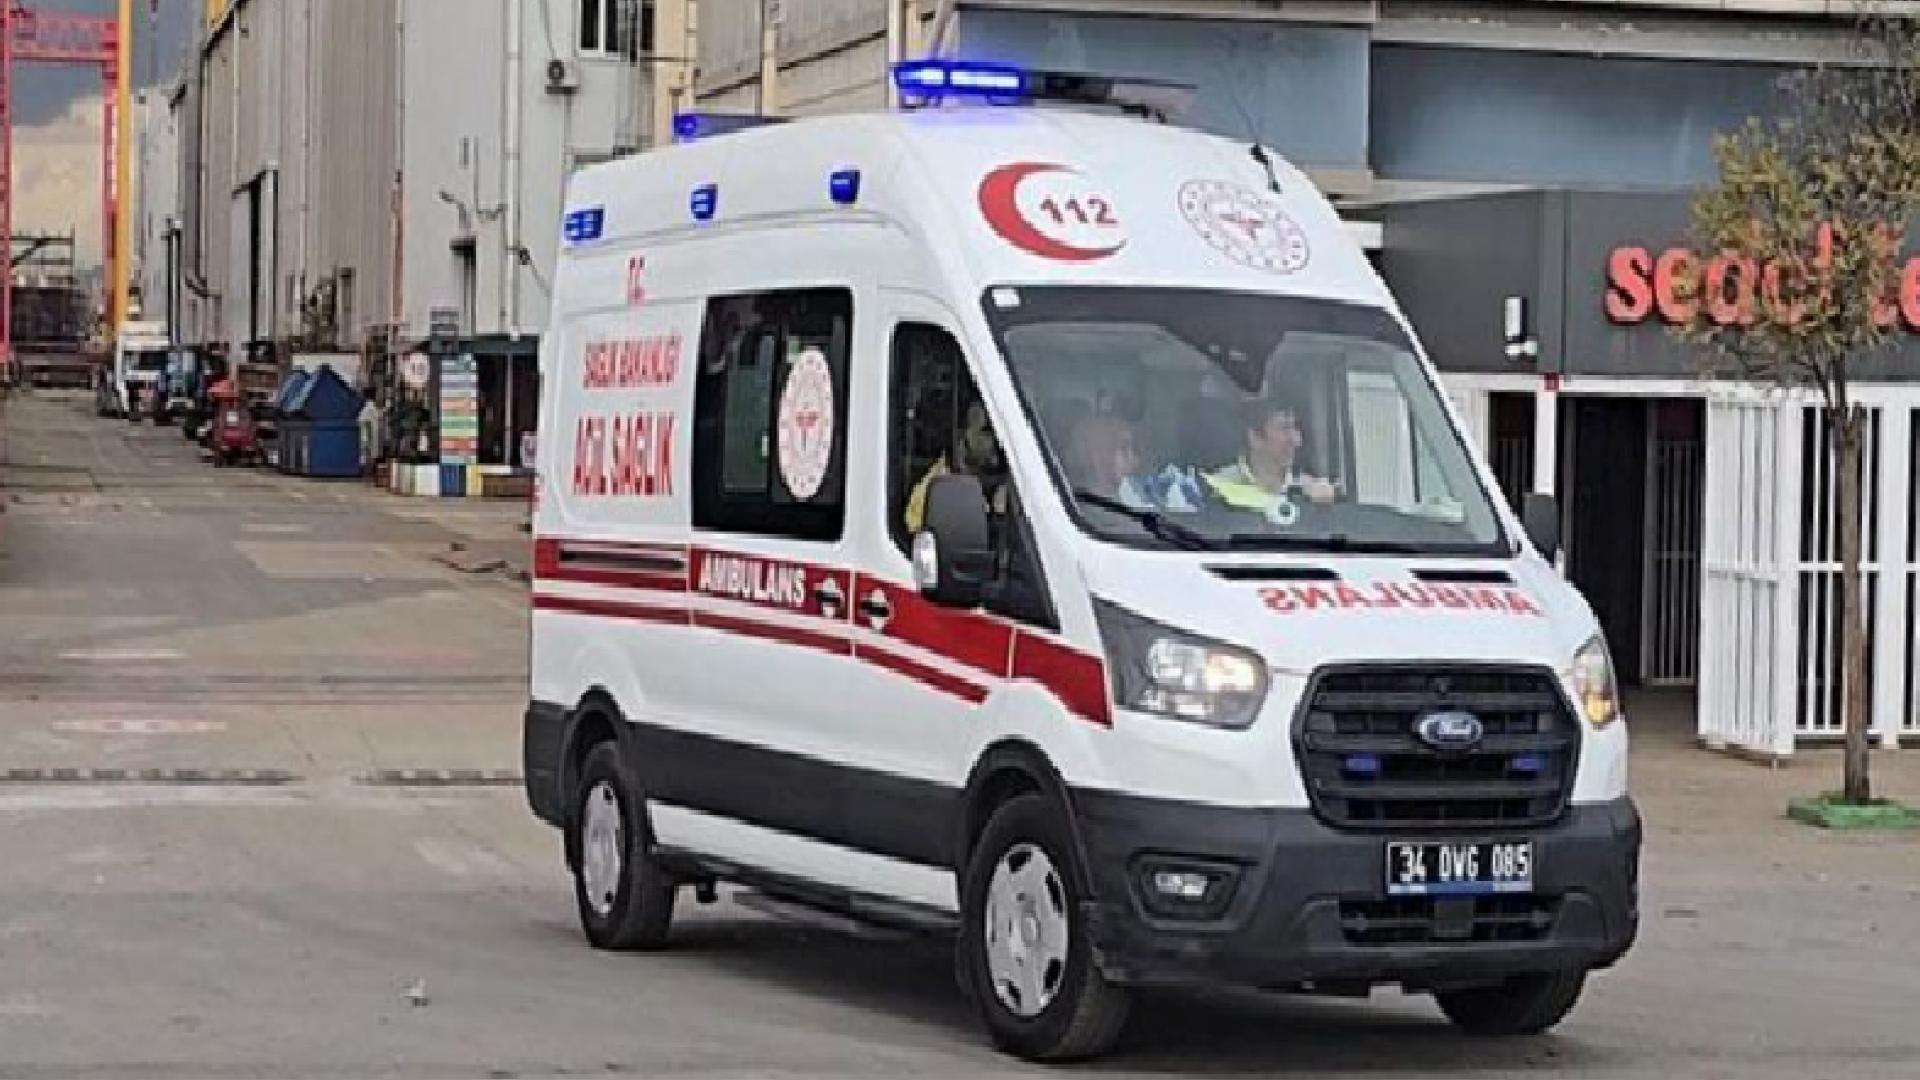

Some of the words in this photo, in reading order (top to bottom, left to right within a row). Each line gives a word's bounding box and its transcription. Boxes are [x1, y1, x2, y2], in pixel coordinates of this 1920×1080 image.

[1040, 194, 1118, 224] 112
[699, 553, 806, 607] AMBULANS
[1400, 846, 1427, 882] 34
[1492, 843, 1529, 878] 085
